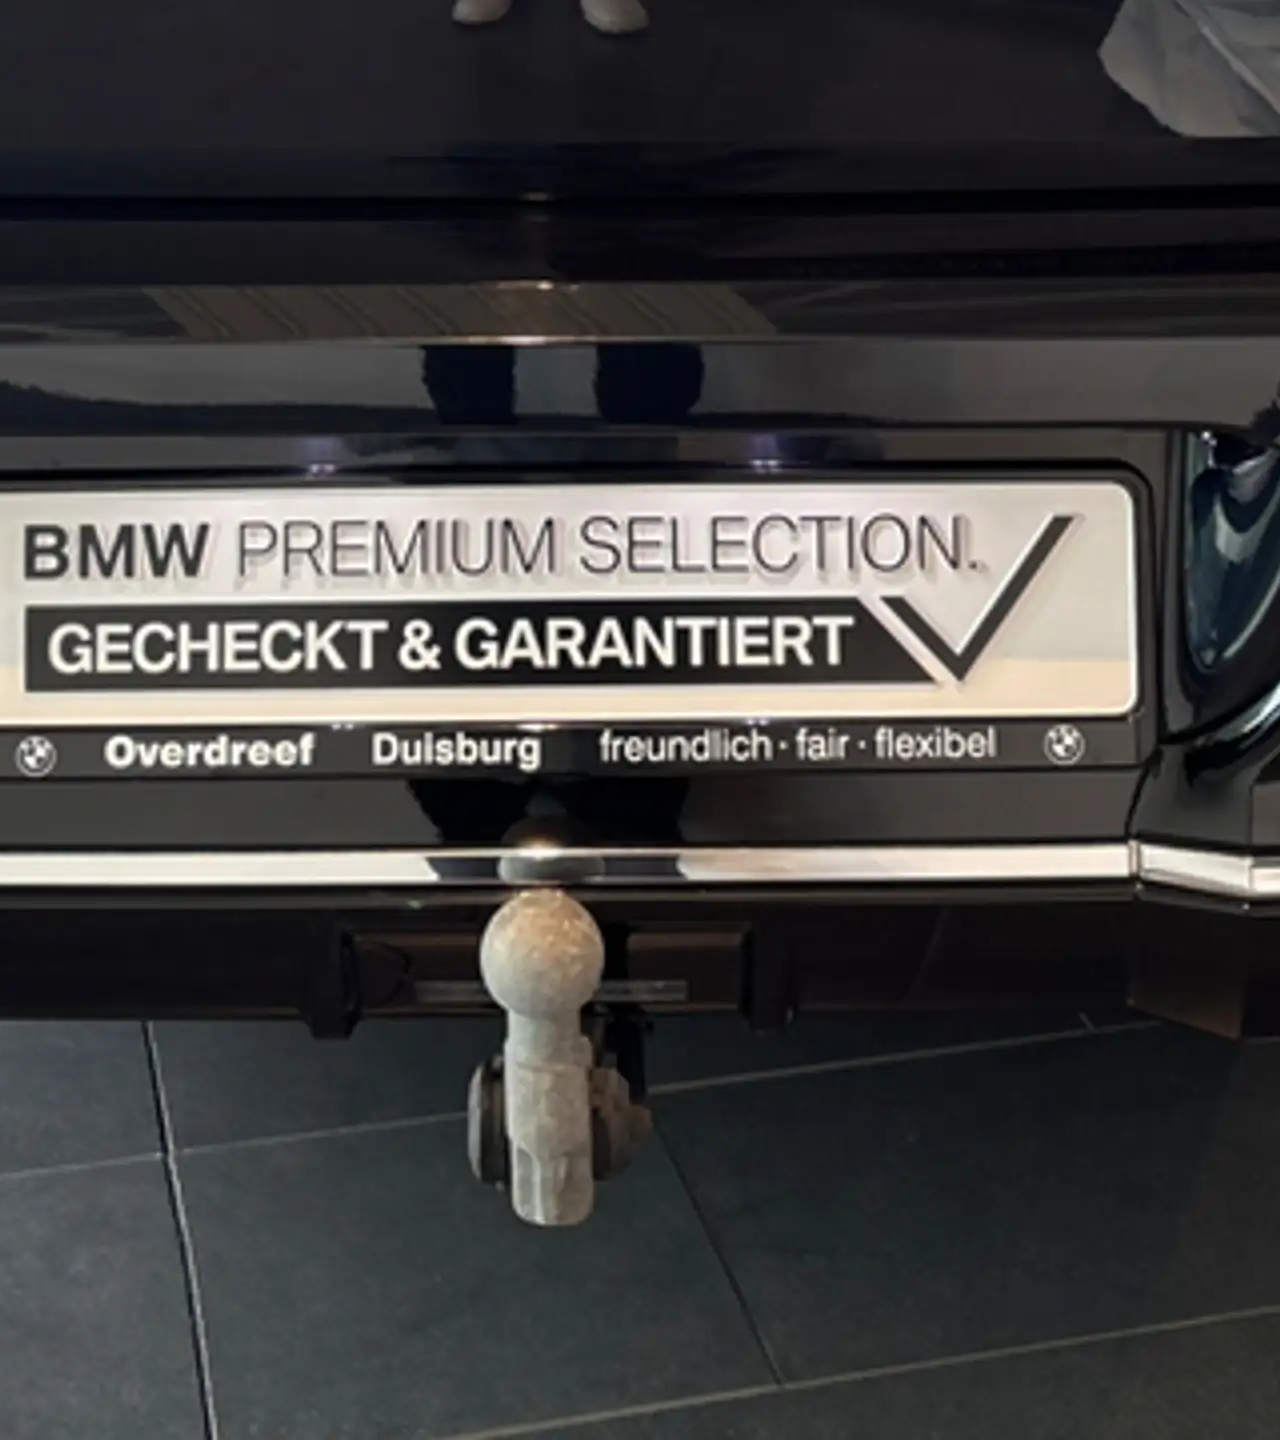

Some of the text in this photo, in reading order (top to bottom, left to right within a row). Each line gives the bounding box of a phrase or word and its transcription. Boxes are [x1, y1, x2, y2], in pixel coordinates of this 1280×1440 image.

[23, 522, 210, 580] BMW
[238, 517, 557, 578] PREMIUM
[47, 614, 856, 675] GECHECKT & GARANTIERT
[104, 724, 999, 771] Overdreef Duisburg freundlich fair flexibel
